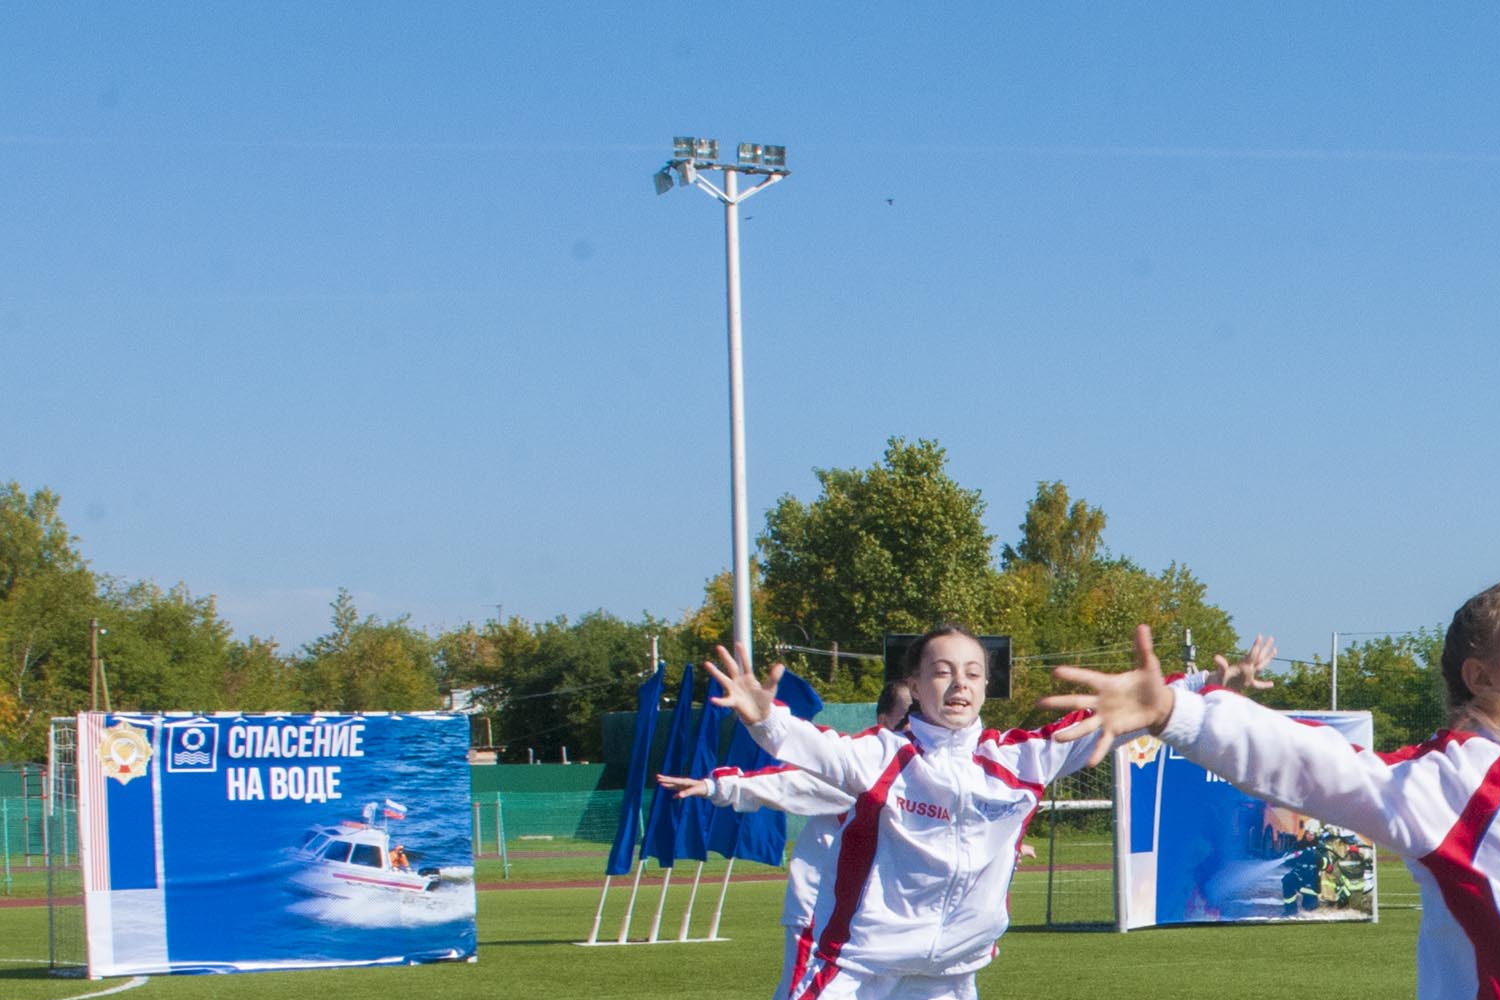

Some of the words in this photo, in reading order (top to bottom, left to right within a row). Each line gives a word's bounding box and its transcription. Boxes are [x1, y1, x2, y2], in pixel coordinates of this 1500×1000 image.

[228, 725, 366, 758] СПАСЕНИЕ
[227, 767, 265, 800] НА
[270, 766, 342, 803] ВОДЕ
[896, 796, 950, 821] RUSSIA
